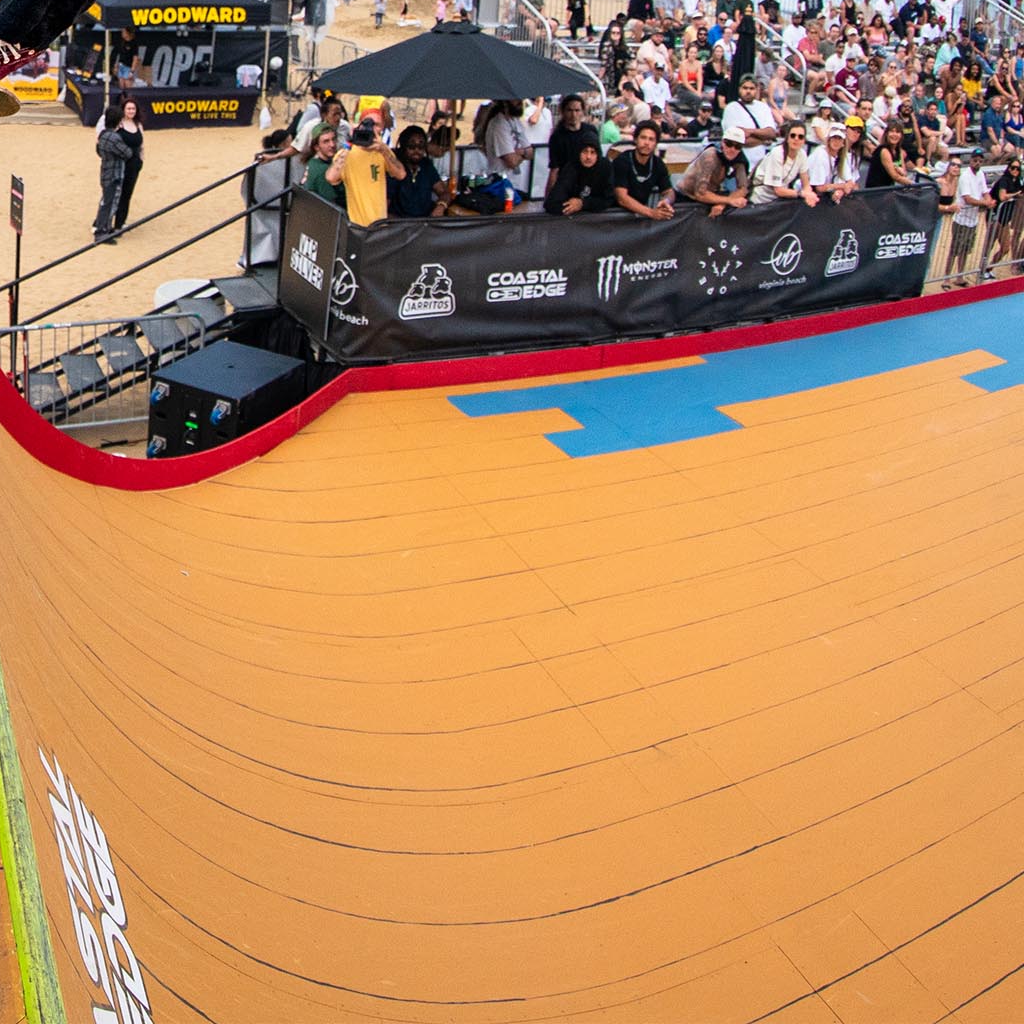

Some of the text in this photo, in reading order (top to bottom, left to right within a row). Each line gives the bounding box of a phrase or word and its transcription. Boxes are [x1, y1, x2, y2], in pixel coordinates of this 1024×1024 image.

[131, 7, 246, 25] WOODWARD
[151, 99, 239, 114] WOODWARD
[878, 232, 927, 246] COASTAL
[898, 243, 927, 257] EDGE
[290, 247, 324, 291] SILVER
[622, 259, 678, 274] MONSTER
[487, 269, 568, 287] COASTAL
[630, 272, 669, 281] ENERGY
[522, 282, 568, 299] EDGE
[404, 299, 450, 314] JARRITOS
[339, 309, 369, 326] beach
